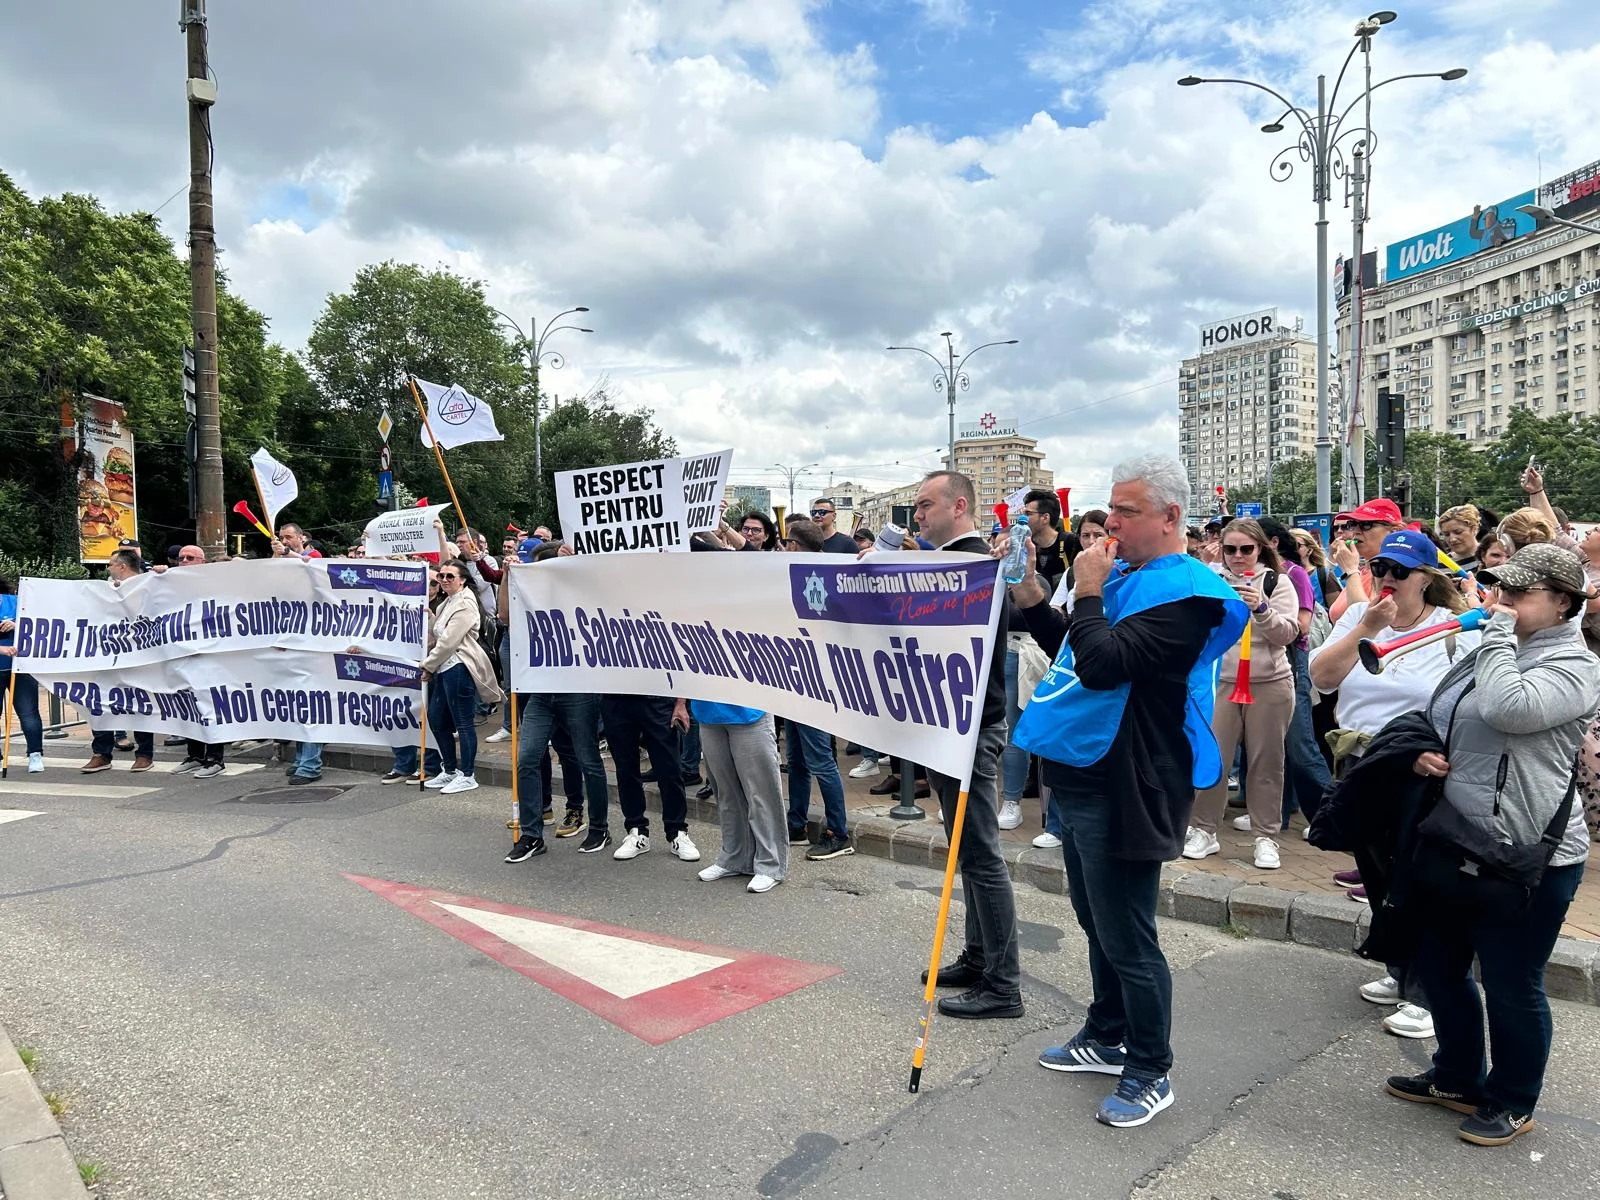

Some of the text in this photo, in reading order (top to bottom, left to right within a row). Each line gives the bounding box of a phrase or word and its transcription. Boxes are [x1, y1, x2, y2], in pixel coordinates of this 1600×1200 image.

[1400, 232, 1454, 271] Wolt
[1475, 290, 1569, 327] EDENT CLINIC
[1203, 316, 1272, 347] HONOR
[446, 413, 468, 421] CARTEL
[960, 428, 1016, 439] REGINA MARIA
[573, 464, 664, 498] RESPECT
[681, 456, 721, 481] MENII
[581, 494, 663, 526] PENTRU
[573, 521, 681, 555] ANGAJAȚI!
[366, 568, 424, 582] Sindicatul IMPAC
[836, 570, 968, 594] Sindicatul IMPACT
[17, 617, 70, 659] BRD:
[75, 619, 98, 658] Tu
[201, 599, 232, 639] Nu
[235, 596, 308, 637] suntem
[311, 597, 373, 638] costuri
[373, 598, 398, 642] de
[365, 660, 396, 676] Sindicatul
[526, 609, 580, 667] BRD:
[672, 620, 739, 679] sunt
[722, 627, 838, 713] oameni,
[825, 642, 879, 717] nu
[109, 687, 153, 716] are
[210, 683, 258, 725] Noi
[260, 688, 332, 725] cerem
